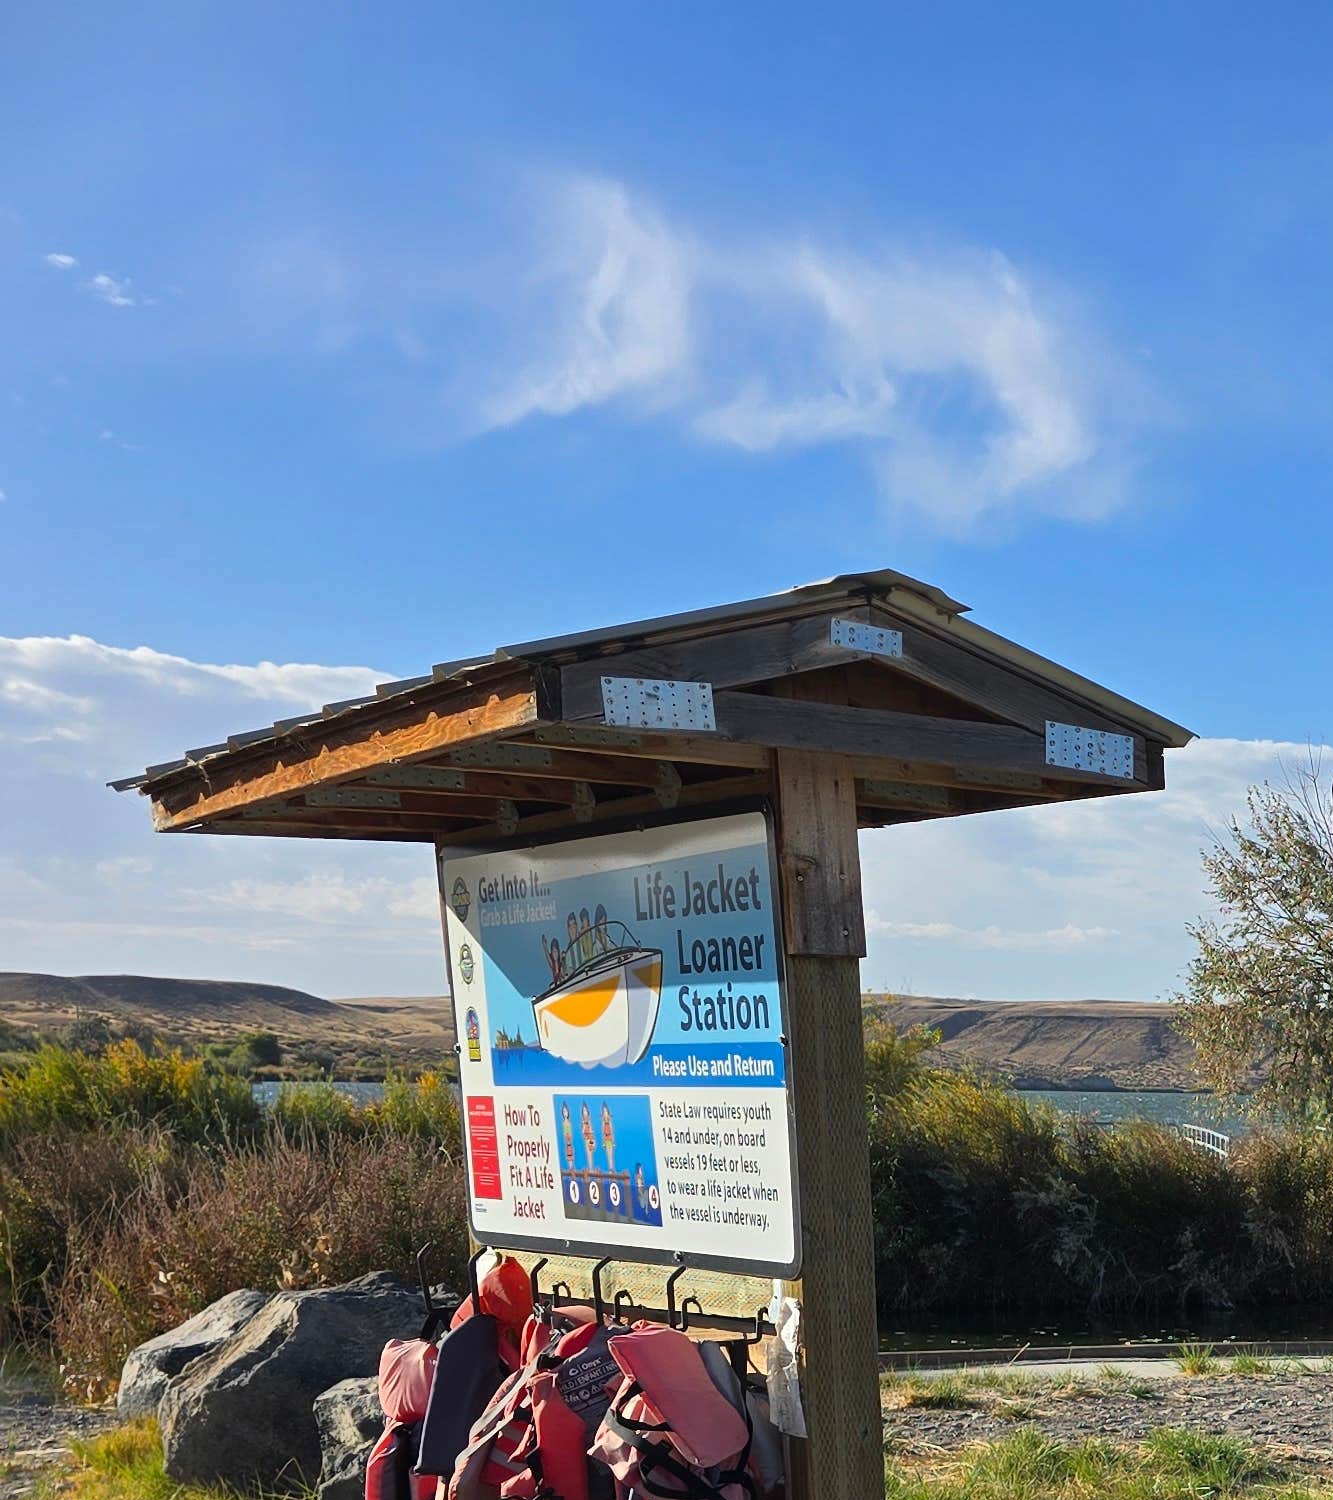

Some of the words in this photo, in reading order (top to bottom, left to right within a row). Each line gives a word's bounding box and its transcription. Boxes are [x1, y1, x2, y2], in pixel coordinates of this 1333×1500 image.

[478, 877, 499, 903] Get
[502, 873, 527, 900] Into
[633, 872, 676, 921] Life
[681, 864, 761, 917] Jacket
[677, 930, 766, 975] Loaner
[679, 982, 769, 1031] Station
[653, 1055, 687, 1076] Please
[688, 1056, 709, 1076] Use
[710, 1054, 732, 1076] and
[734, 1055, 774, 1076] Return
[505, 1105, 526, 1126] How
[528, 1105, 540, 1126] To
[660, 1101, 681, 1118] State
[683, 1102, 700, 1118] Law
[704, 1103, 741, 1123] requires
[743, 1104, 771, 1124] youth
[663, 1128, 672, 1143] 14
[675, 1128, 691, 1143] and
[693, 1129, 721, 1147] under,
[724, 1133, 735, 1145] on
[738, 1130, 765, 1147] board
[507, 1135, 549, 1164] Properly
[665, 1154, 694, 1170] vessels
[697, 1155, 707, 1170] 19
[709, 1155, 727, 1172] feet
[730, 1160, 738, 1172] or
[741, 1157, 760, 1176] less,
[510, 1166, 523, 1187] Fit
[526, 1167, 533, 1187] A
[535, 1167, 553, 1189] Life
[667, 1180, 676, 1194] to
[678, 1183, 698, 1195] wear
[701, 1184, 705, 1196] a
[708, 1181, 721, 1197] life
[724, 1182, 751, 1201] jacket
[753, 1184, 778, 1201] when
[514, 1198, 545, 1219] Jacket
[670, 1204, 684, 1219] the
[686, 1207, 711, 1222] vessel
[713, 1207, 720, 1223] is
[722, 1209, 769, 1232] underway.
